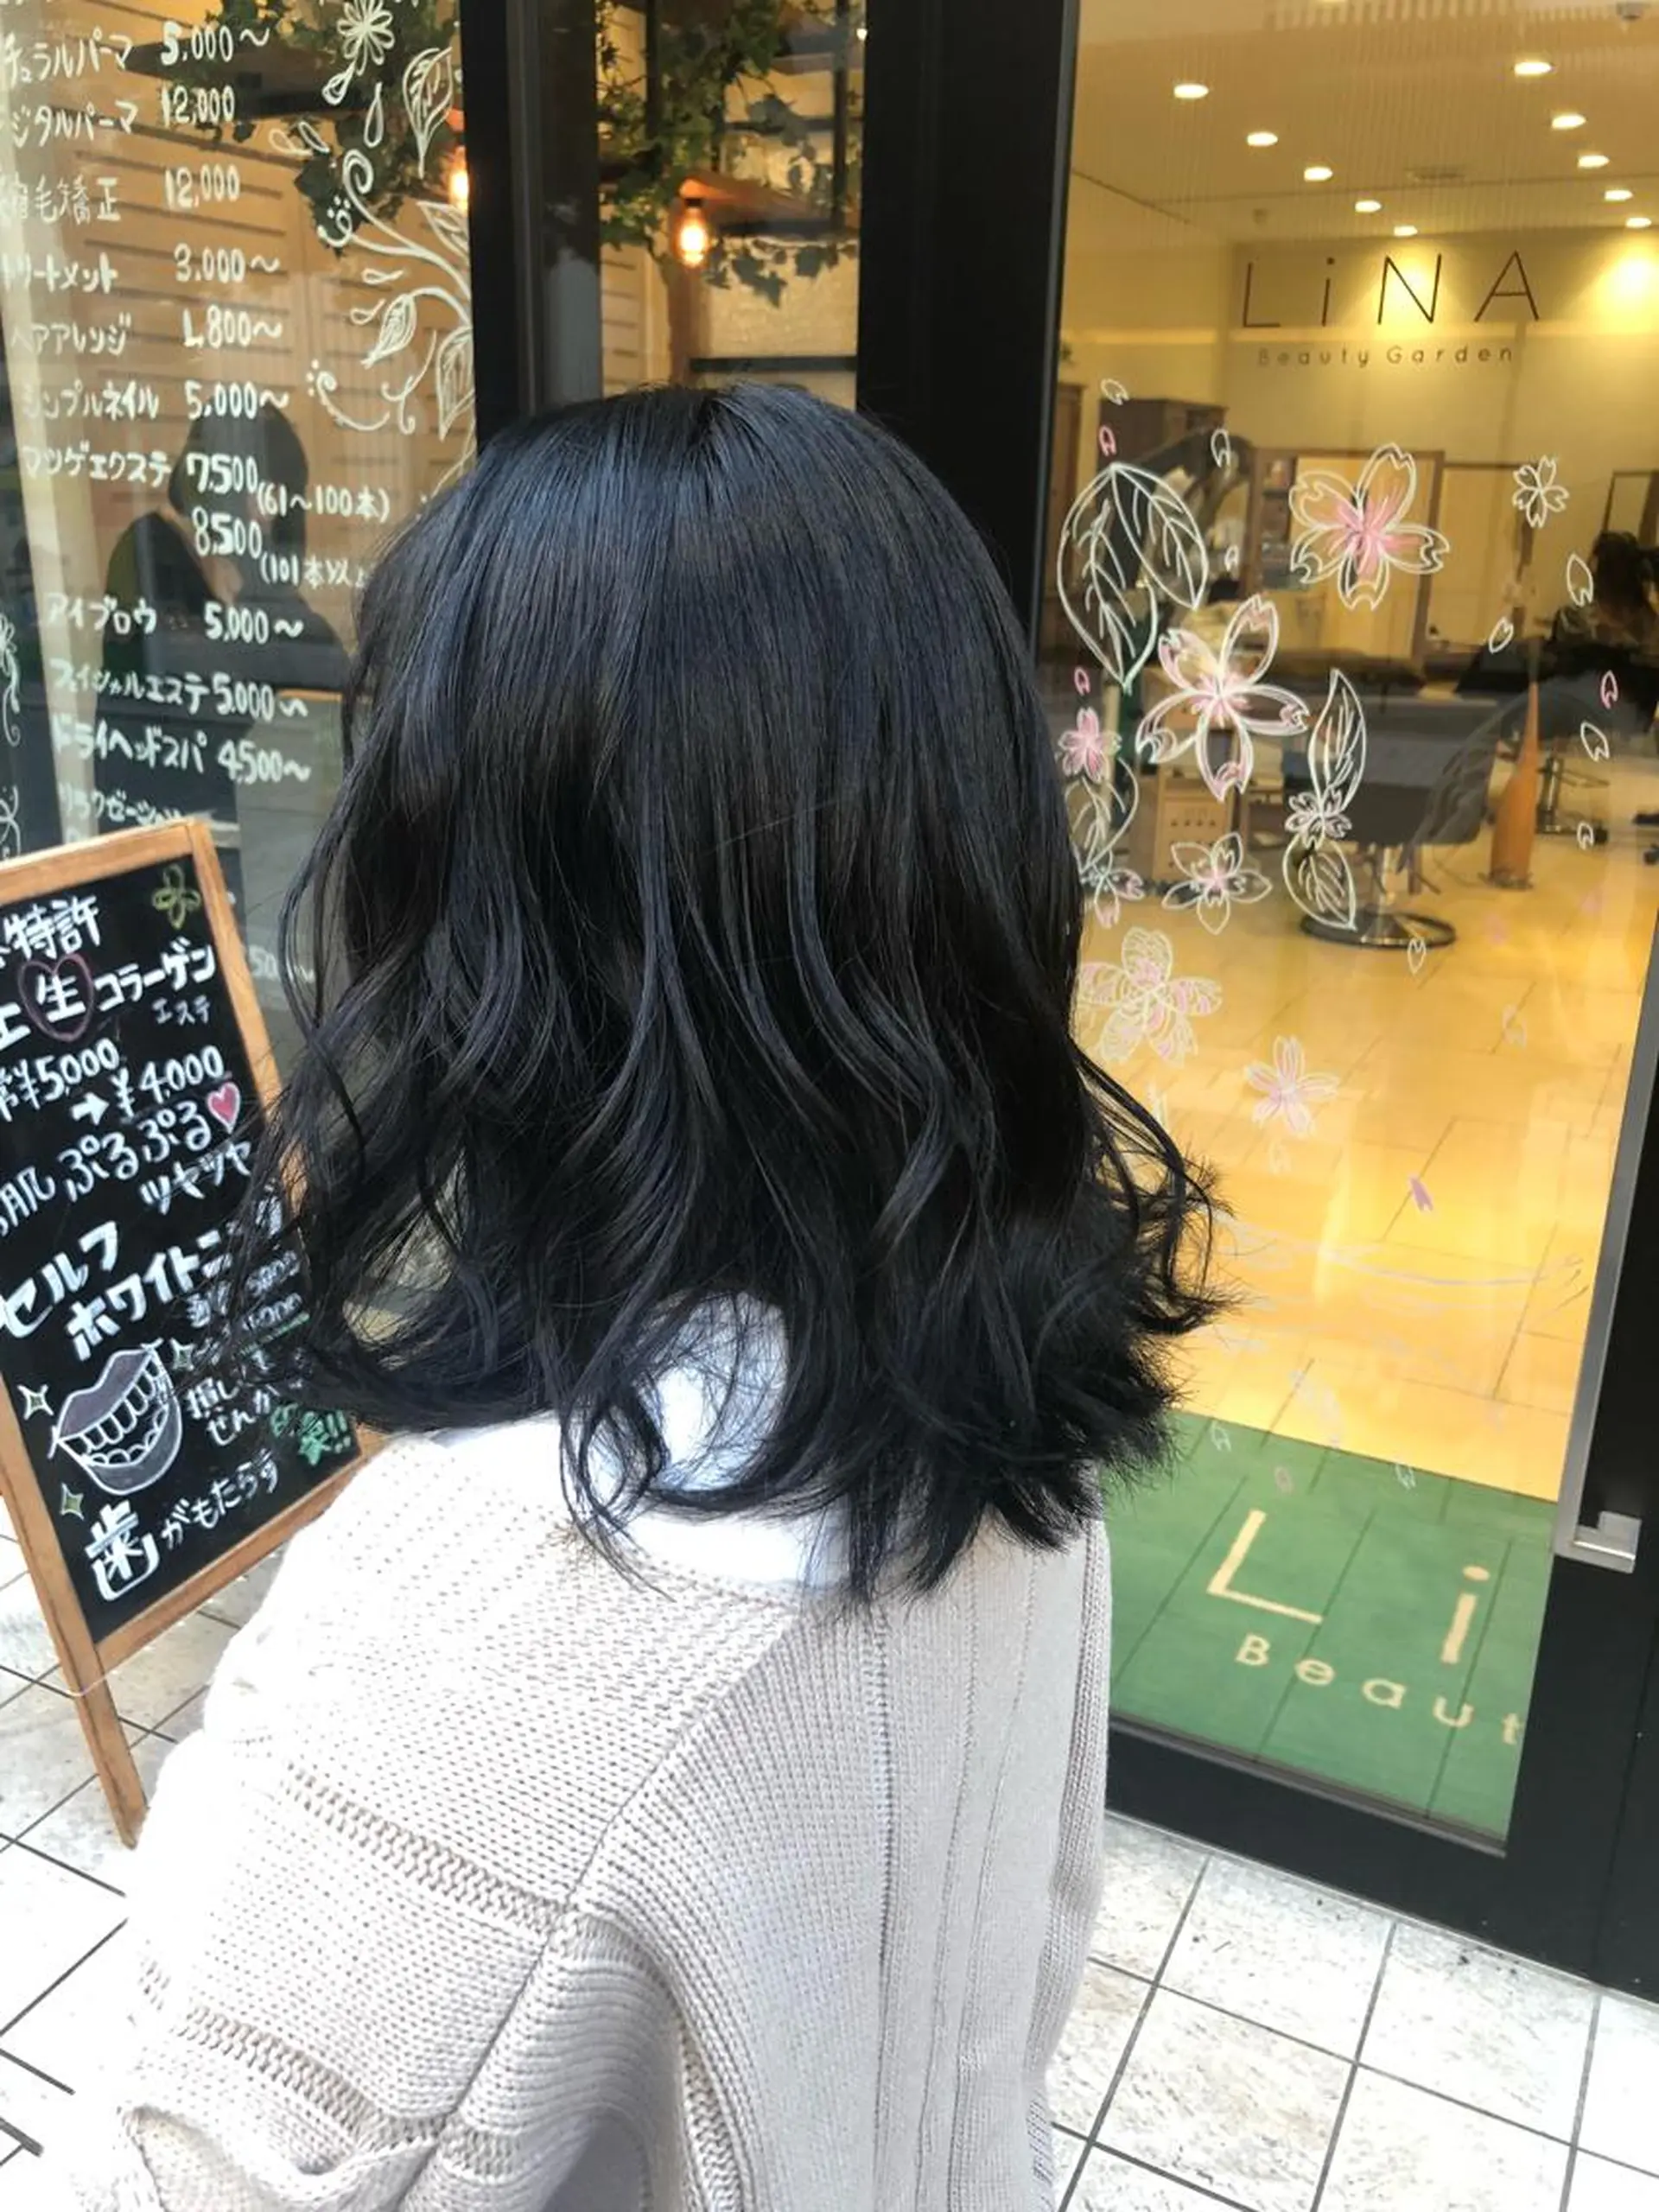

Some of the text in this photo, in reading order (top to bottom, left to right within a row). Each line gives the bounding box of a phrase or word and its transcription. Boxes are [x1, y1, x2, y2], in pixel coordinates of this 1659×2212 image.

[1242, 250, 1541, 329] LiNA
[1257, 345, 1514, 369] Beauty Garden
[151, 995, 211, 1026] エステ
